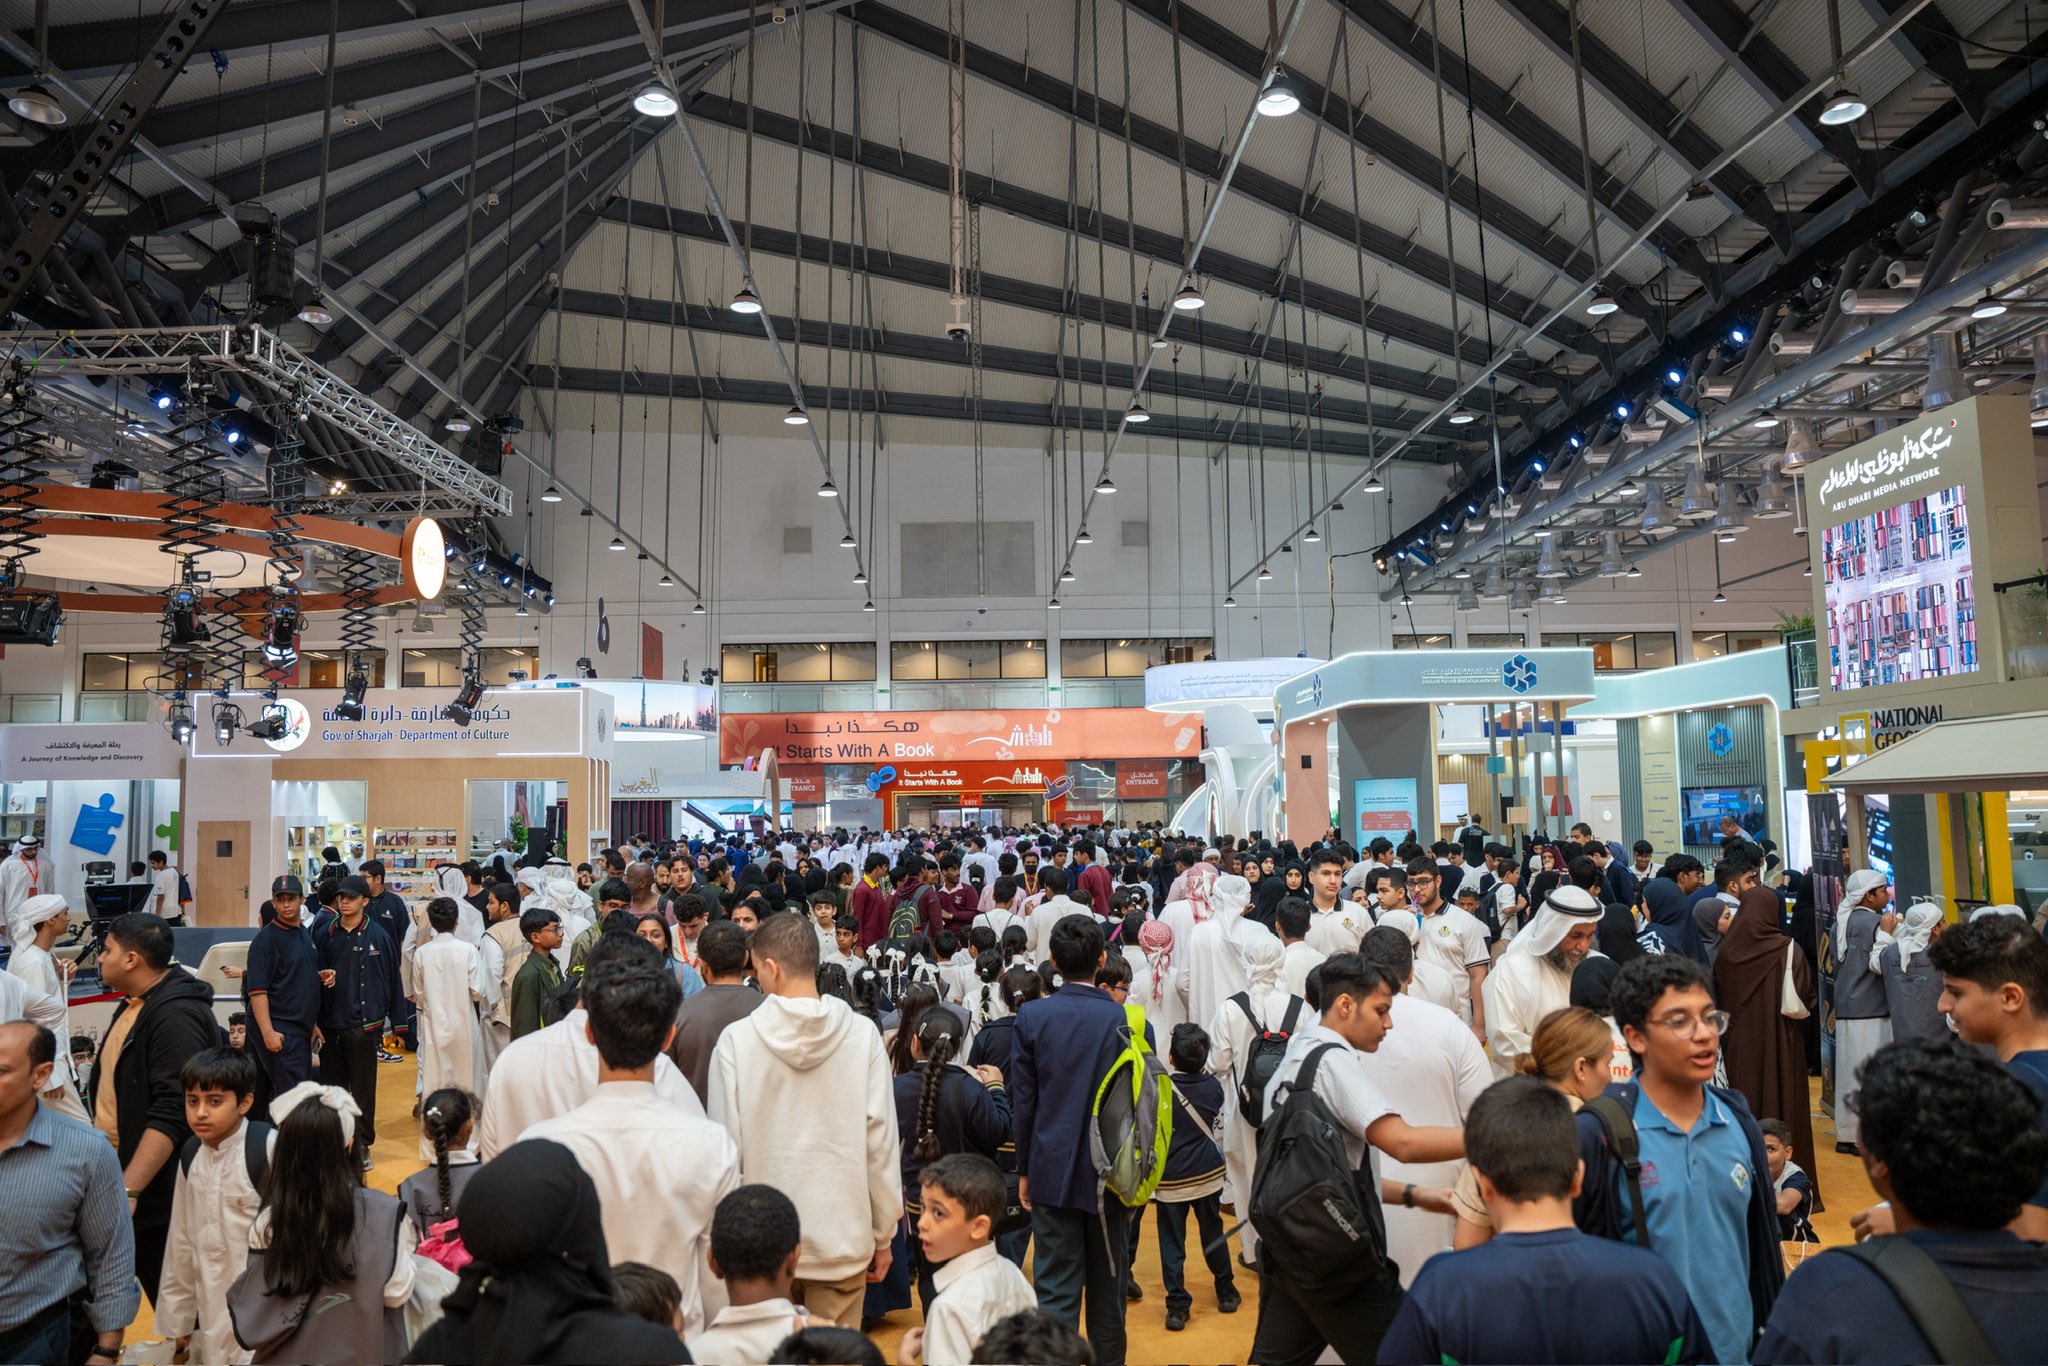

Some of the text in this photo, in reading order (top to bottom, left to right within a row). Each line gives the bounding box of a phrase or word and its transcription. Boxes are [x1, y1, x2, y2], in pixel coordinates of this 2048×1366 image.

[1832, 466, 1941, 512] ABU DHABI MEDIA NETWORK
[470, 704, 510, 724] حكوم
[322, 729, 342, 741] Gov.
[344, 729, 355, 741] of
[357, 729, 393, 743] Sharjah
[400, 729, 458, 743] Department
[461, 728, 472, 740] of
[473, 728, 510, 740] Culture
[786, 744, 833, 758] Starts
[837, 743, 872, 758] With
[877, 743, 890, 757] A
[894, 742, 935, 757] Book
[63, 755, 98, 763] Knowledge
[946, 778, 964, 786] Book
[619, 786, 660, 794] MOROCCO
[1322, 1198, 1360, 1242] SKECHERS
